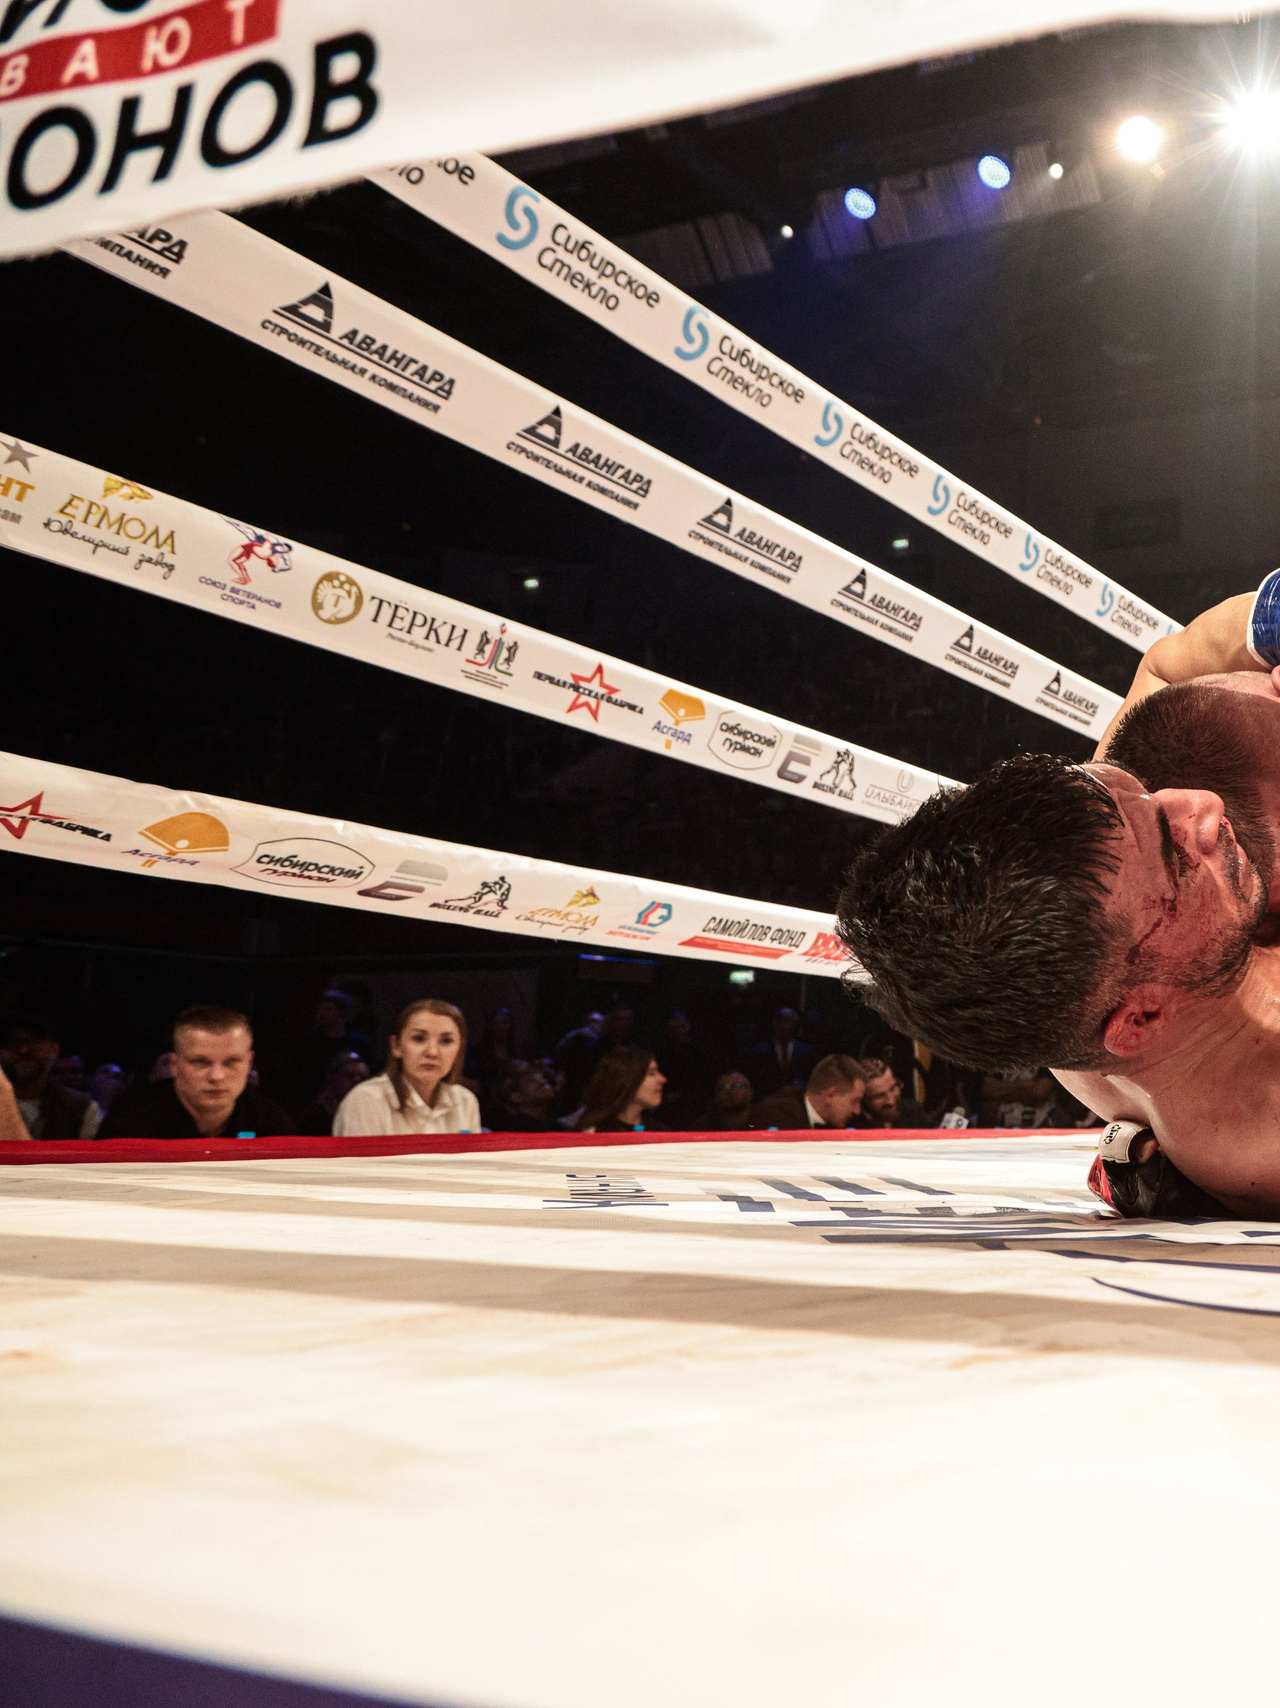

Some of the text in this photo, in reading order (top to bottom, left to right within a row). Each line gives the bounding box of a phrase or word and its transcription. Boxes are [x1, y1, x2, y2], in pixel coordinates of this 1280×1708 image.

[6, 31, 380, 211] ОНОВ
[537, 247, 620, 311] Стекло
[551, 223, 661, 308] Сибирское
[260, 318, 442, 414] СТРОИТЕЛЬНАЯ КОМПАНИЯ
[338, 327, 457, 399] АВАНГАРД
[706, 356, 772, 408] Стекло
[718, 335, 805, 403] Сибирское
[565, 441, 653, 497] АВАНГАРД
[839, 441, 892, 484] Стекло
[850, 422, 920, 478] Сибирское
[947, 510, 991, 546] Стекло
[956, 492, 1013, 539] Сибирское
[734, 527, 804, 573] АВАНГАРД
[1043, 549, 1093, 589] Сибирское
[1036, 565, 1074, 597] Стекло
[868, 593, 923, 631] АВАНГАРД
[1111, 609, 1143, 638] Стекло
[1118, 594, 1160, 630] Сибирское
[651, 720, 693, 745] Асгард
[256, 853, 364, 880] сибирский
[702, 916, 807, 949] САМОЙЛОВ ФОНД
